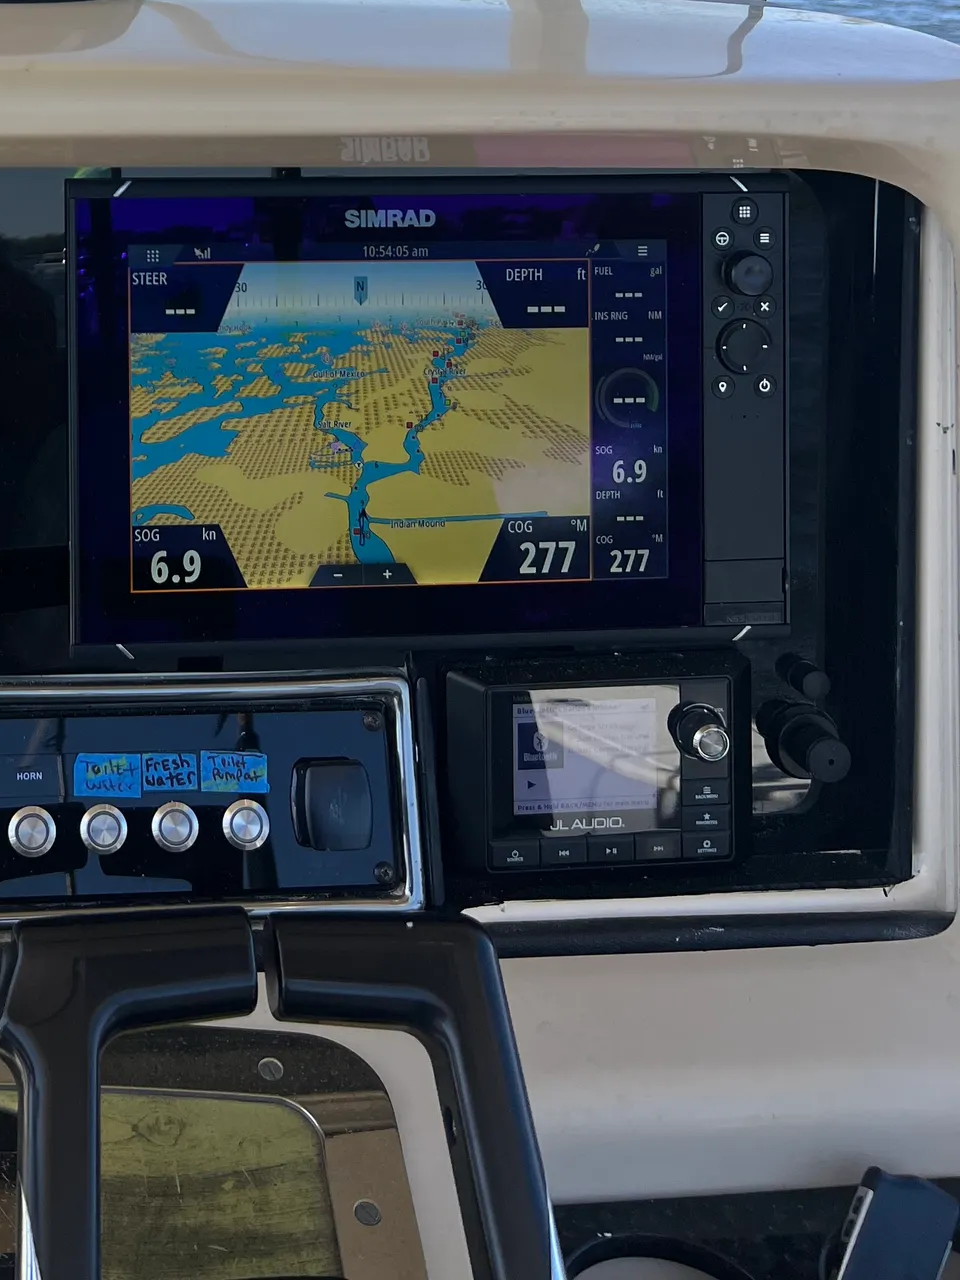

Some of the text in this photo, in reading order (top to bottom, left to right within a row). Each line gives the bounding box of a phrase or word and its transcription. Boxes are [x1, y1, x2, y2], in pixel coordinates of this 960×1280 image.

[344, 209, 436, 228] SIMRAD
[362, 245, 429, 258] 10:54:05 am
[506, 269, 543, 281] DEPTH
[577, 268, 586, 280] ft
[595, 267, 613, 275] FUEL
[650, 266, 662, 277] gal
[132, 272, 167, 285] STEER
[356, 280, 365, 291] N
[610, 311, 628, 320] RNG
[648, 311, 662, 319] NM
[339, 370, 365, 378] Mexico
[317, 420, 352, 428] Salt River
[595, 446, 613, 454] SOG
[654, 445, 662, 453] kn
[612, 460, 647, 483] 6.9
[596, 490, 621, 499] DEPTH
[657, 489, 664, 498] ft
[508, 521, 533, 533] COG
[134, 529, 160, 542] SOG
[202, 527, 216, 541] kn
[596, 535, 613, 544] COG
[519, 541, 576, 574] 277
[610, 549, 650, 573] 277
[151, 549, 202, 584] 6.9
[523, 753, 557, 762] Bluetooth
[16, 772, 42, 780] HORN
[517, 804, 536, 812] Press
[550, 816, 623, 831] JL AUDIO
